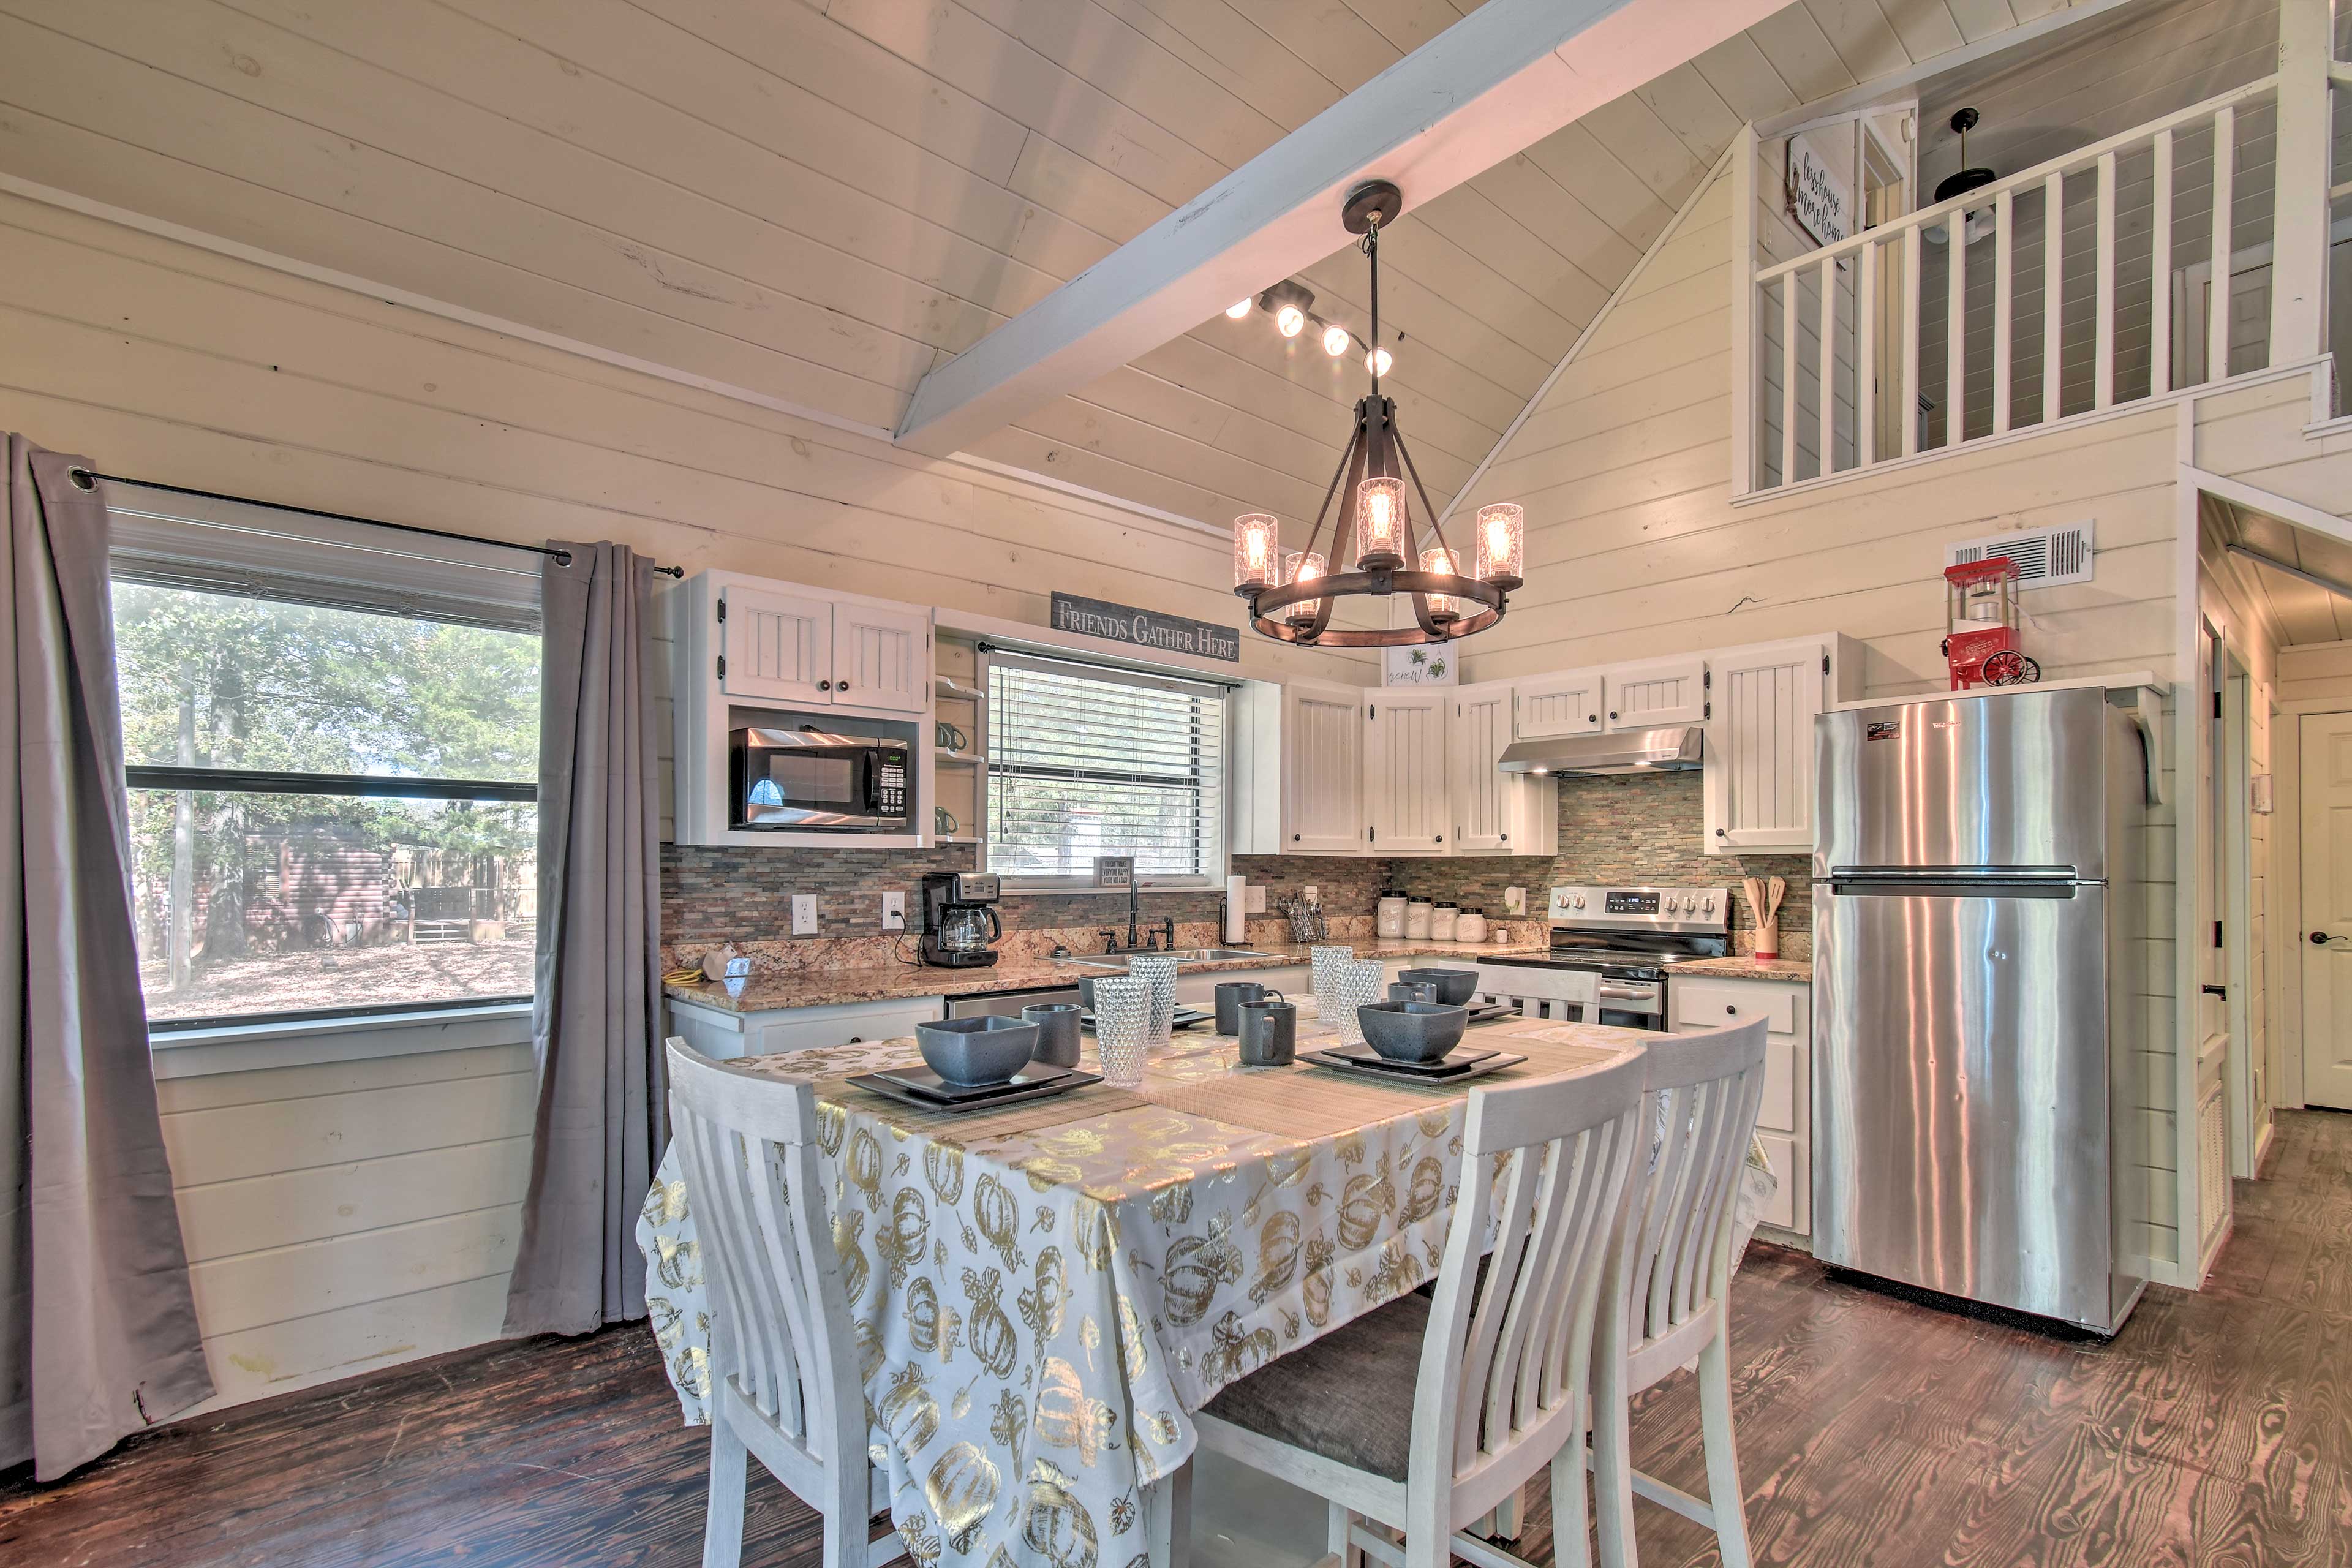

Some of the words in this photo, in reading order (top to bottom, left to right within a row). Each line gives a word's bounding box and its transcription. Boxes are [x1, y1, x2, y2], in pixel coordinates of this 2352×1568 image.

[1798, 186, 1821, 227] more
[1803, 151, 1819, 195] less
[1819, 169, 1841, 216] house
[1057, 600, 1128, 640] FRIENDS
[1133, 614, 1194, 652] GATHER
[1196, 627, 1235, 659] HERE
